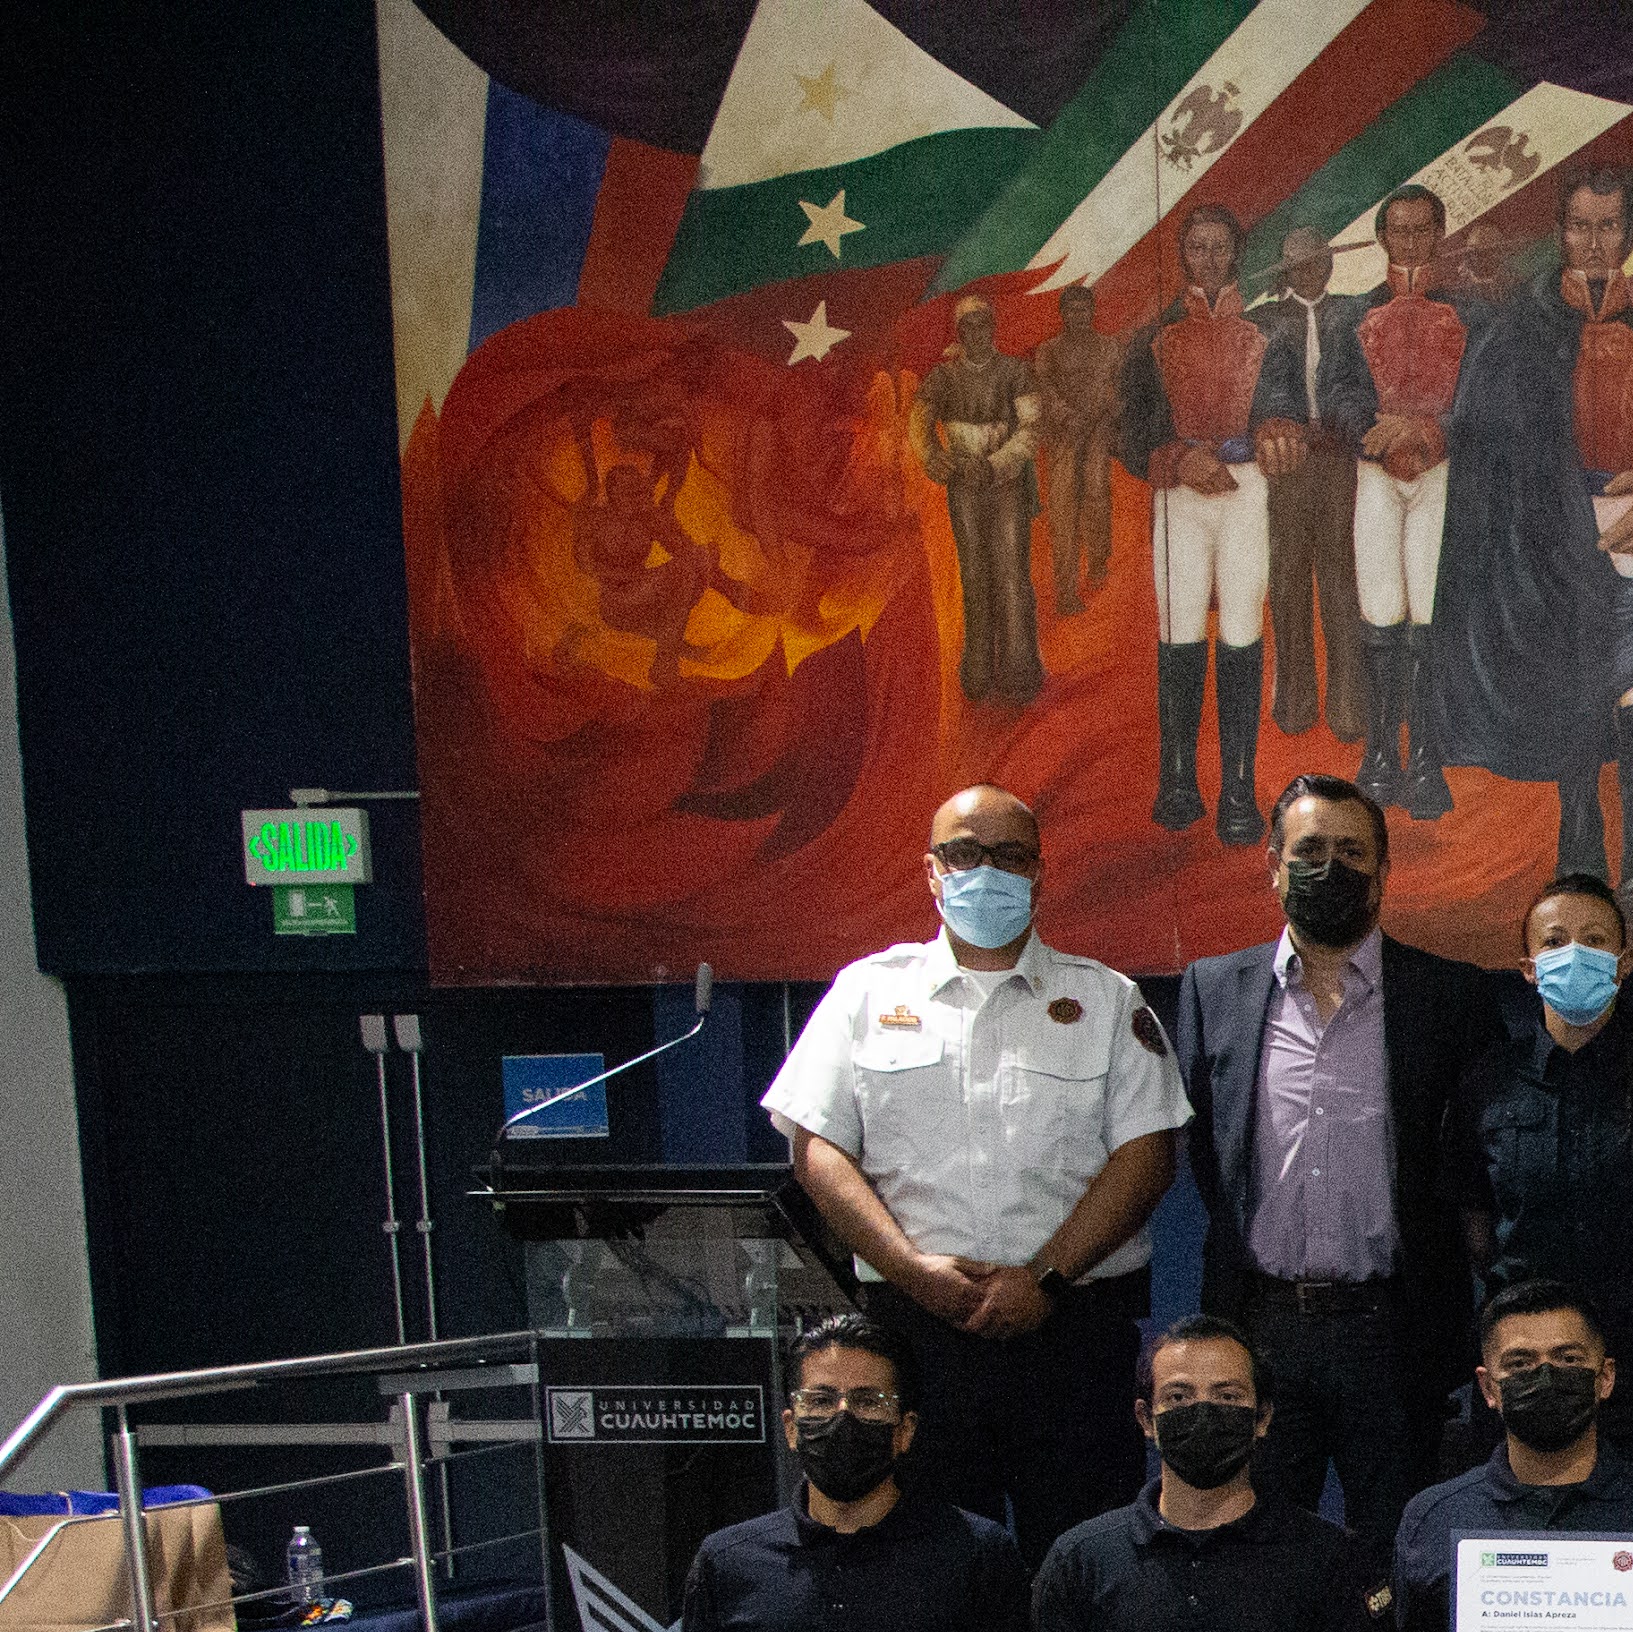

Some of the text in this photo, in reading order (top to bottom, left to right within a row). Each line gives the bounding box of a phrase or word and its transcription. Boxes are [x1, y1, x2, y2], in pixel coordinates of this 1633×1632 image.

[261, 820, 348, 871] SALIDA
[598, 1400, 756, 1411] UNIVERSIDAD
[600, 1413, 756, 1429] CUAUHTEMOC
[1480, 1591, 1628, 1607] CONSTANCIA
[1494, 1610, 1521, 1618] Daniel
[1545, 1611, 1577, 1619] Apreza
